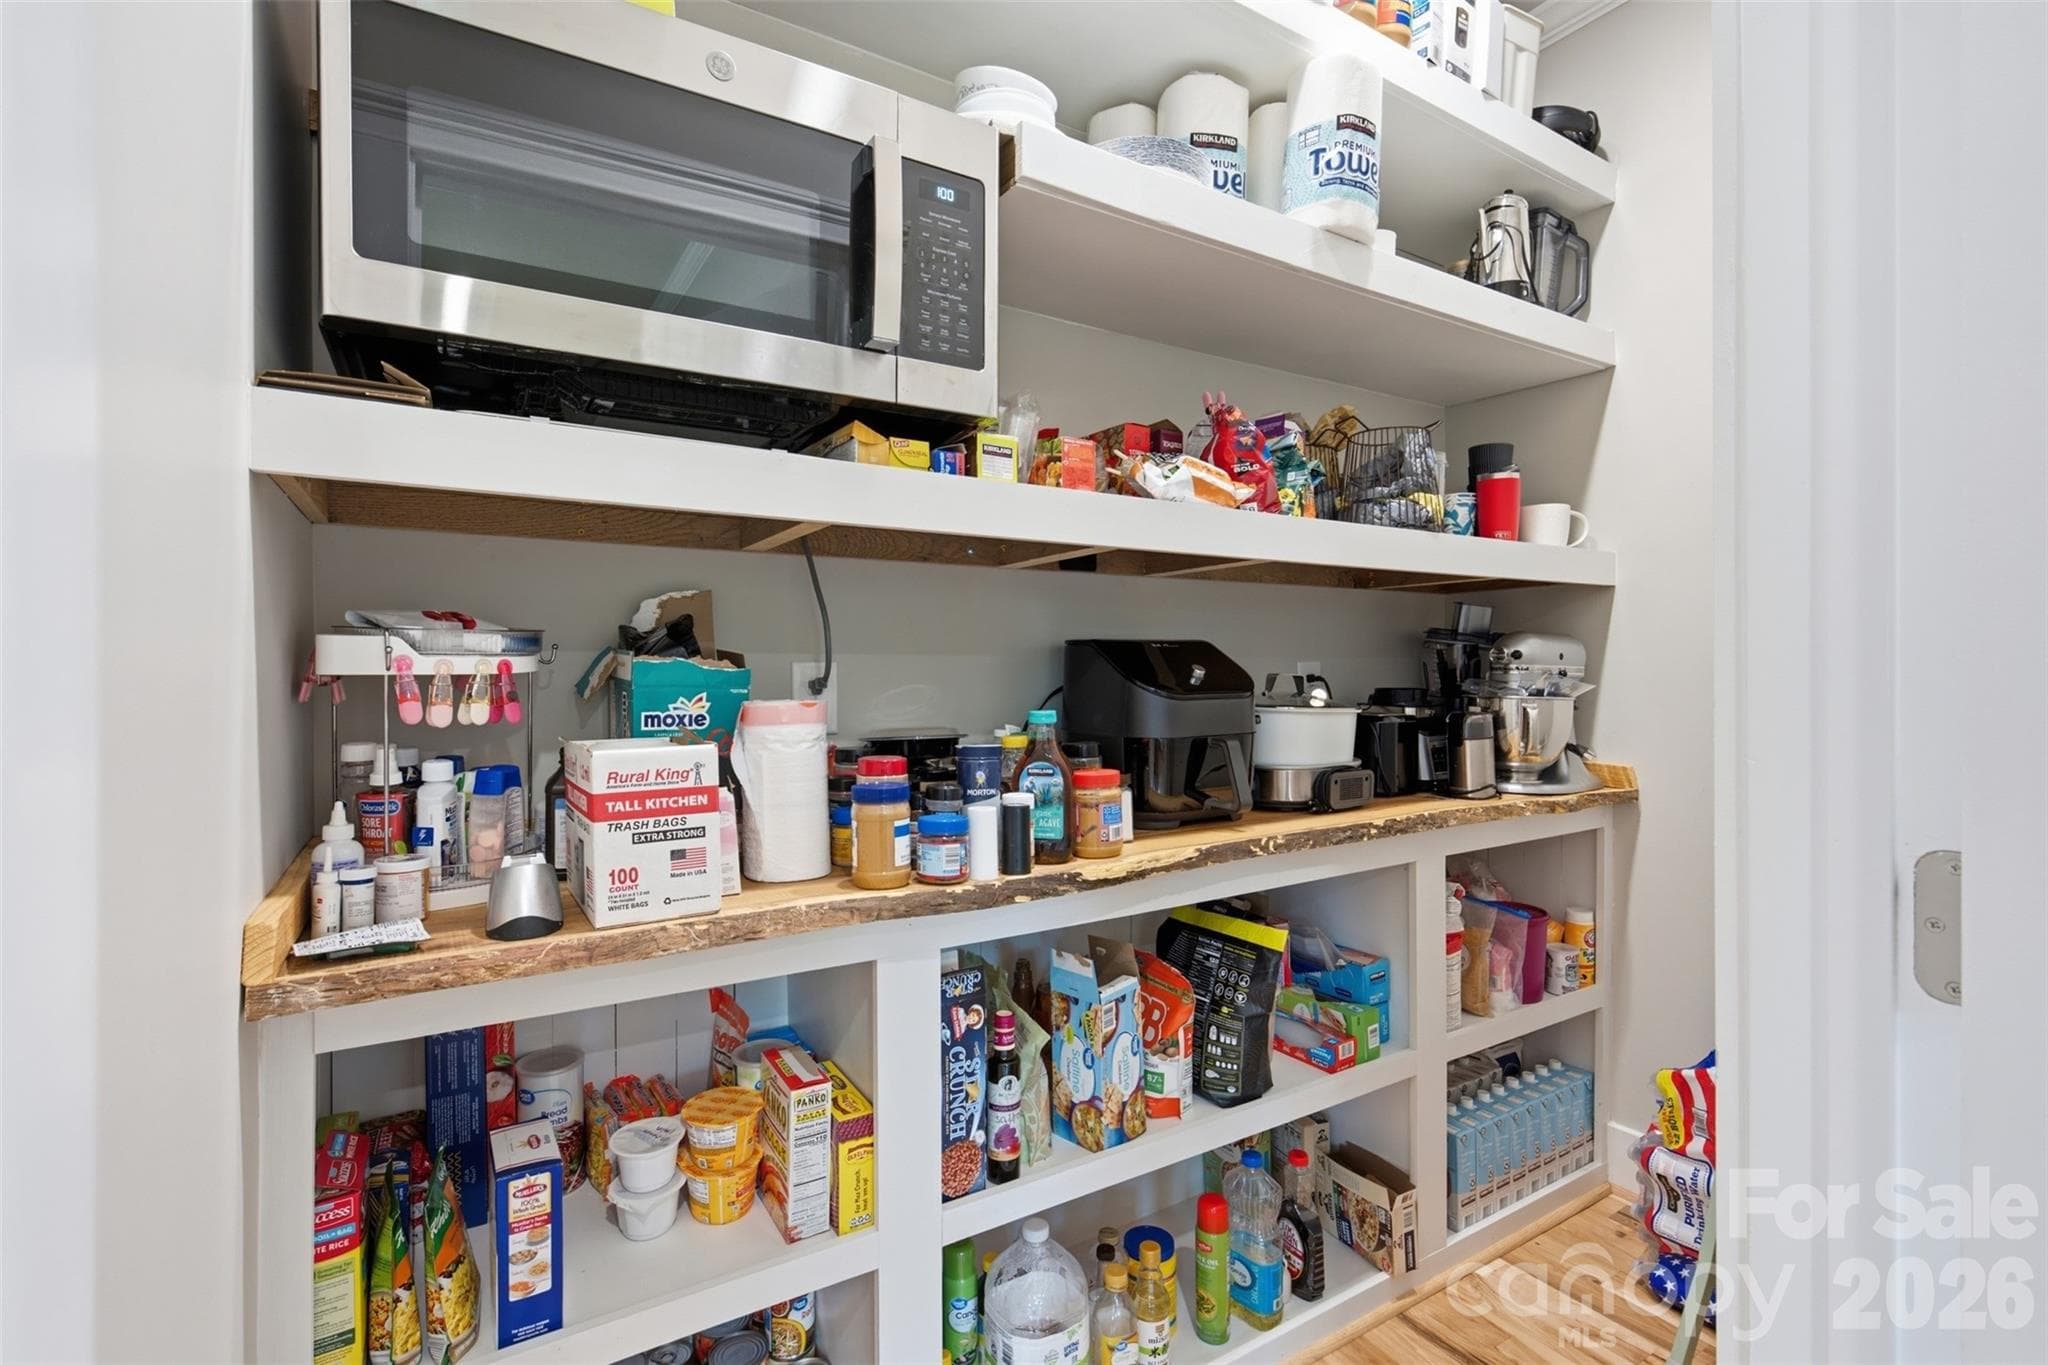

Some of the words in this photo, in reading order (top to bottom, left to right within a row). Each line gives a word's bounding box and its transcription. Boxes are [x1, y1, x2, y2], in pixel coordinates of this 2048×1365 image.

[1193, 134, 1237, 146] KIRKLAND
[1211, 160, 1238, 171] MIUM
[1309, 147, 1378, 184] Towe
[606, 769, 650, 785] Rural
[655, 767, 690, 783] King
[605, 801, 643, 813] TALL
[646, 795, 708, 810] KITCHEN
[361, 817, 381, 828] SORE
[607, 820, 650, 833] TRASH
[653, 817, 688, 829] BAGS
[1039, 819, 1061, 828] AGAVE
[633, 831, 665, 843] EXTRA
[667, 828, 704, 840] STRONG
[608, 867, 639, 886] 100
[609, 884, 640, 894] COUNT
[608, 902, 629, 912] WHITE
[630, 901, 649, 909] BAGS
[796, 1093, 826, 1106] PANKO
[949, 1046, 966, 1141] CRUNCH
[541, 1106, 568, 1118] Bread
[1689, 1166, 1701, 1197] Water
[315, 1205, 351, 1223] ccess
[328, 1238, 350, 1251] RICE
